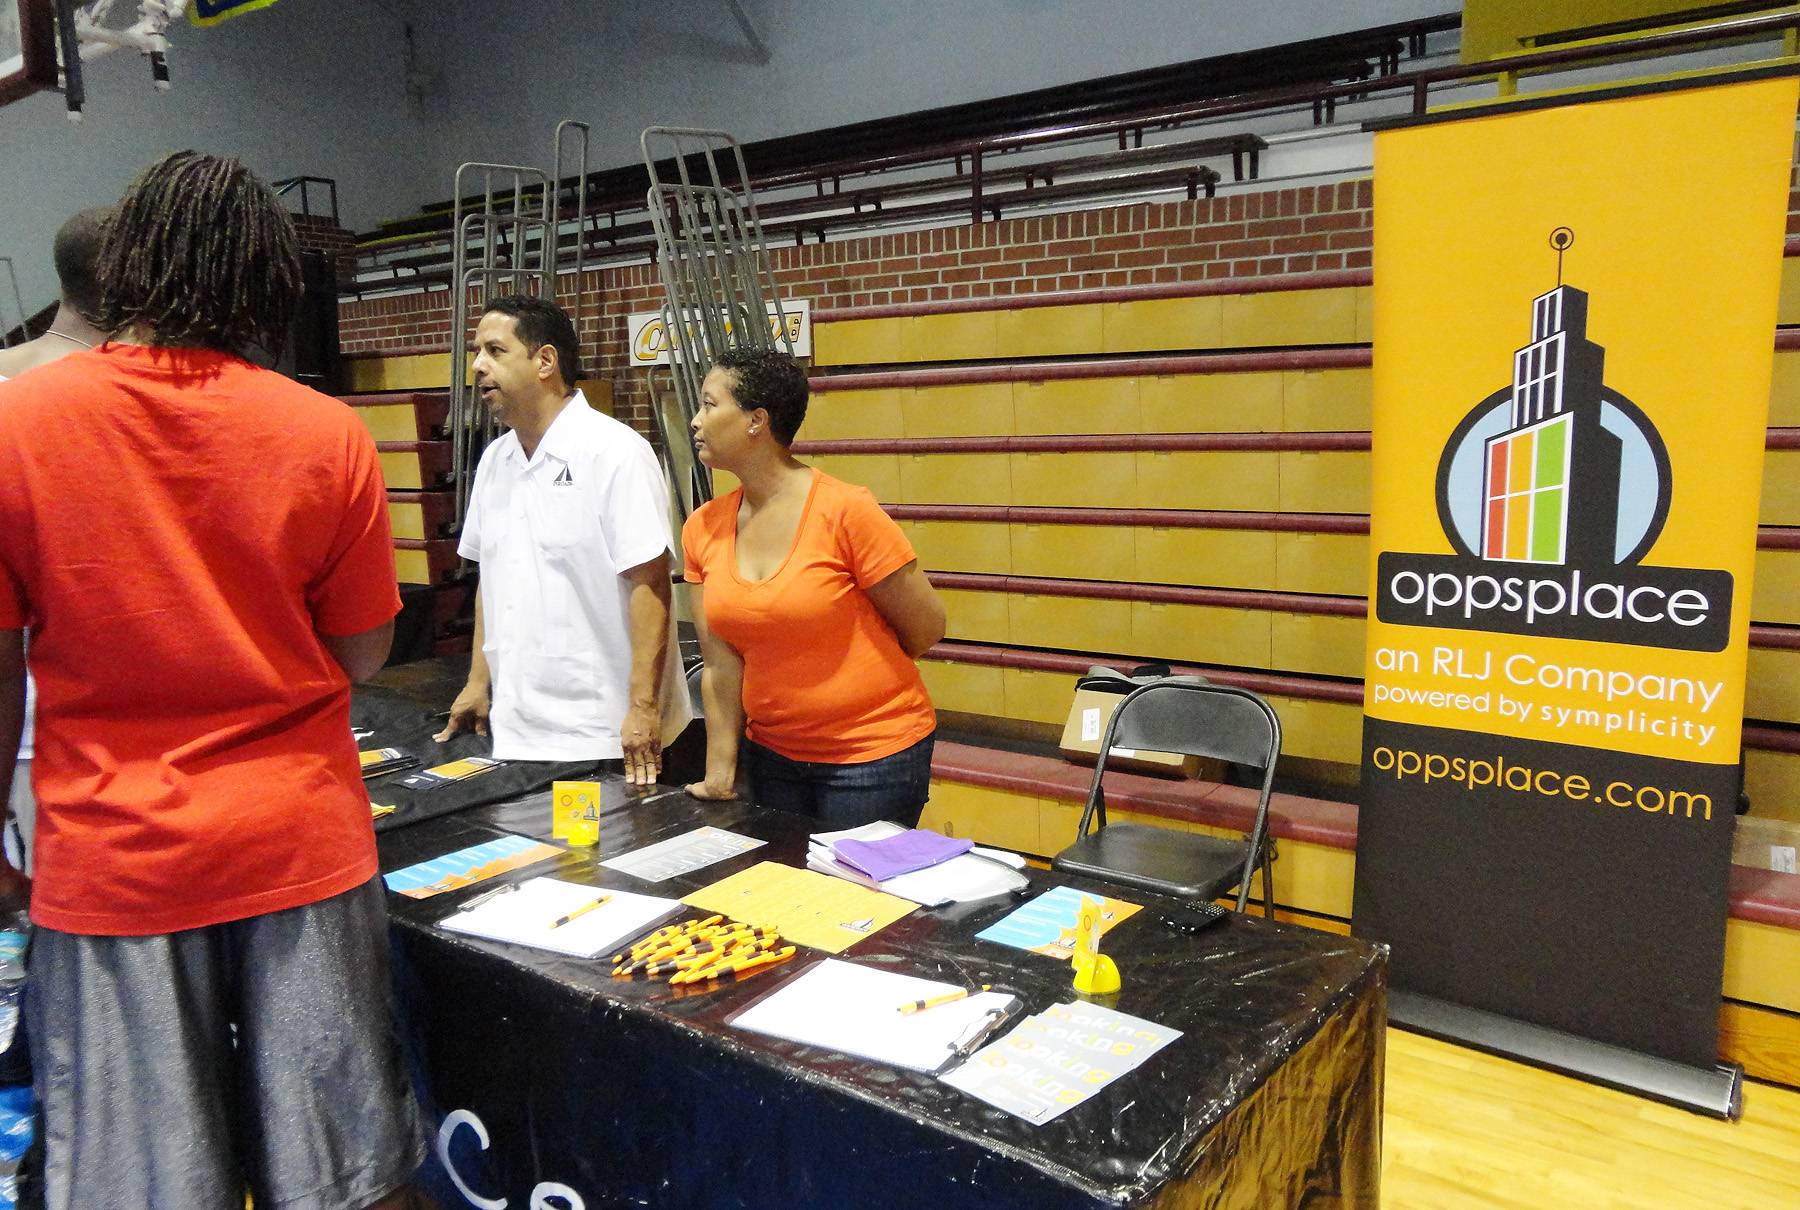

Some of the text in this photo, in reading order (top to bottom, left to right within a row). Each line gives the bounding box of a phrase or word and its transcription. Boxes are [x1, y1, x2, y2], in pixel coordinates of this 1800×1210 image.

[1389, 568, 1710, 628] oppsplace
[1374, 646, 1725, 714] an RLJ Company
[1374, 682, 1718, 748] powered by symplicity
[1372, 744, 1713, 822] oppsplace.com
